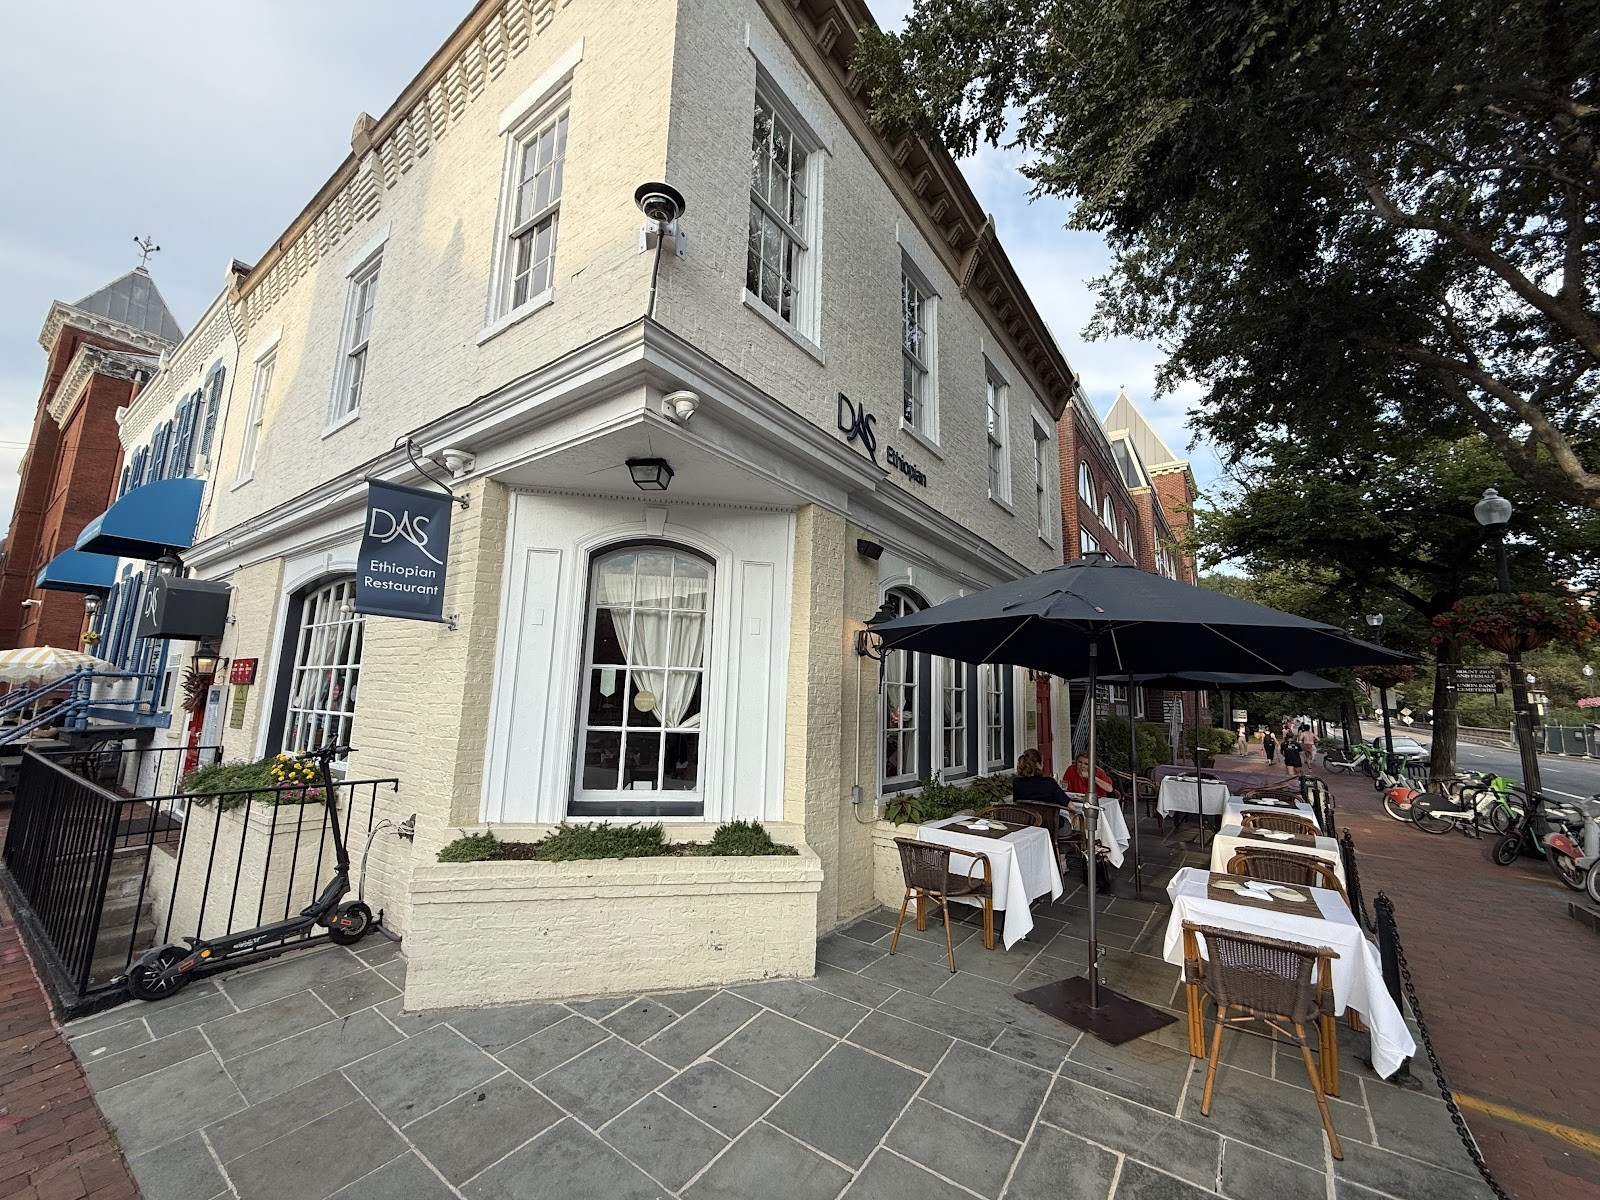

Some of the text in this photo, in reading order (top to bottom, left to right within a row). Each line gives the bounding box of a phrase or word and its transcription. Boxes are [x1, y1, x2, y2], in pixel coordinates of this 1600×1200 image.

[838, 391, 878, 467] DAS
[886, 445, 927, 488] Ethiopian
[368, 507, 444, 566] DAS
[364, 575, 439, 596] Restaurant
[370, 559, 436, 579] Ethiopian
